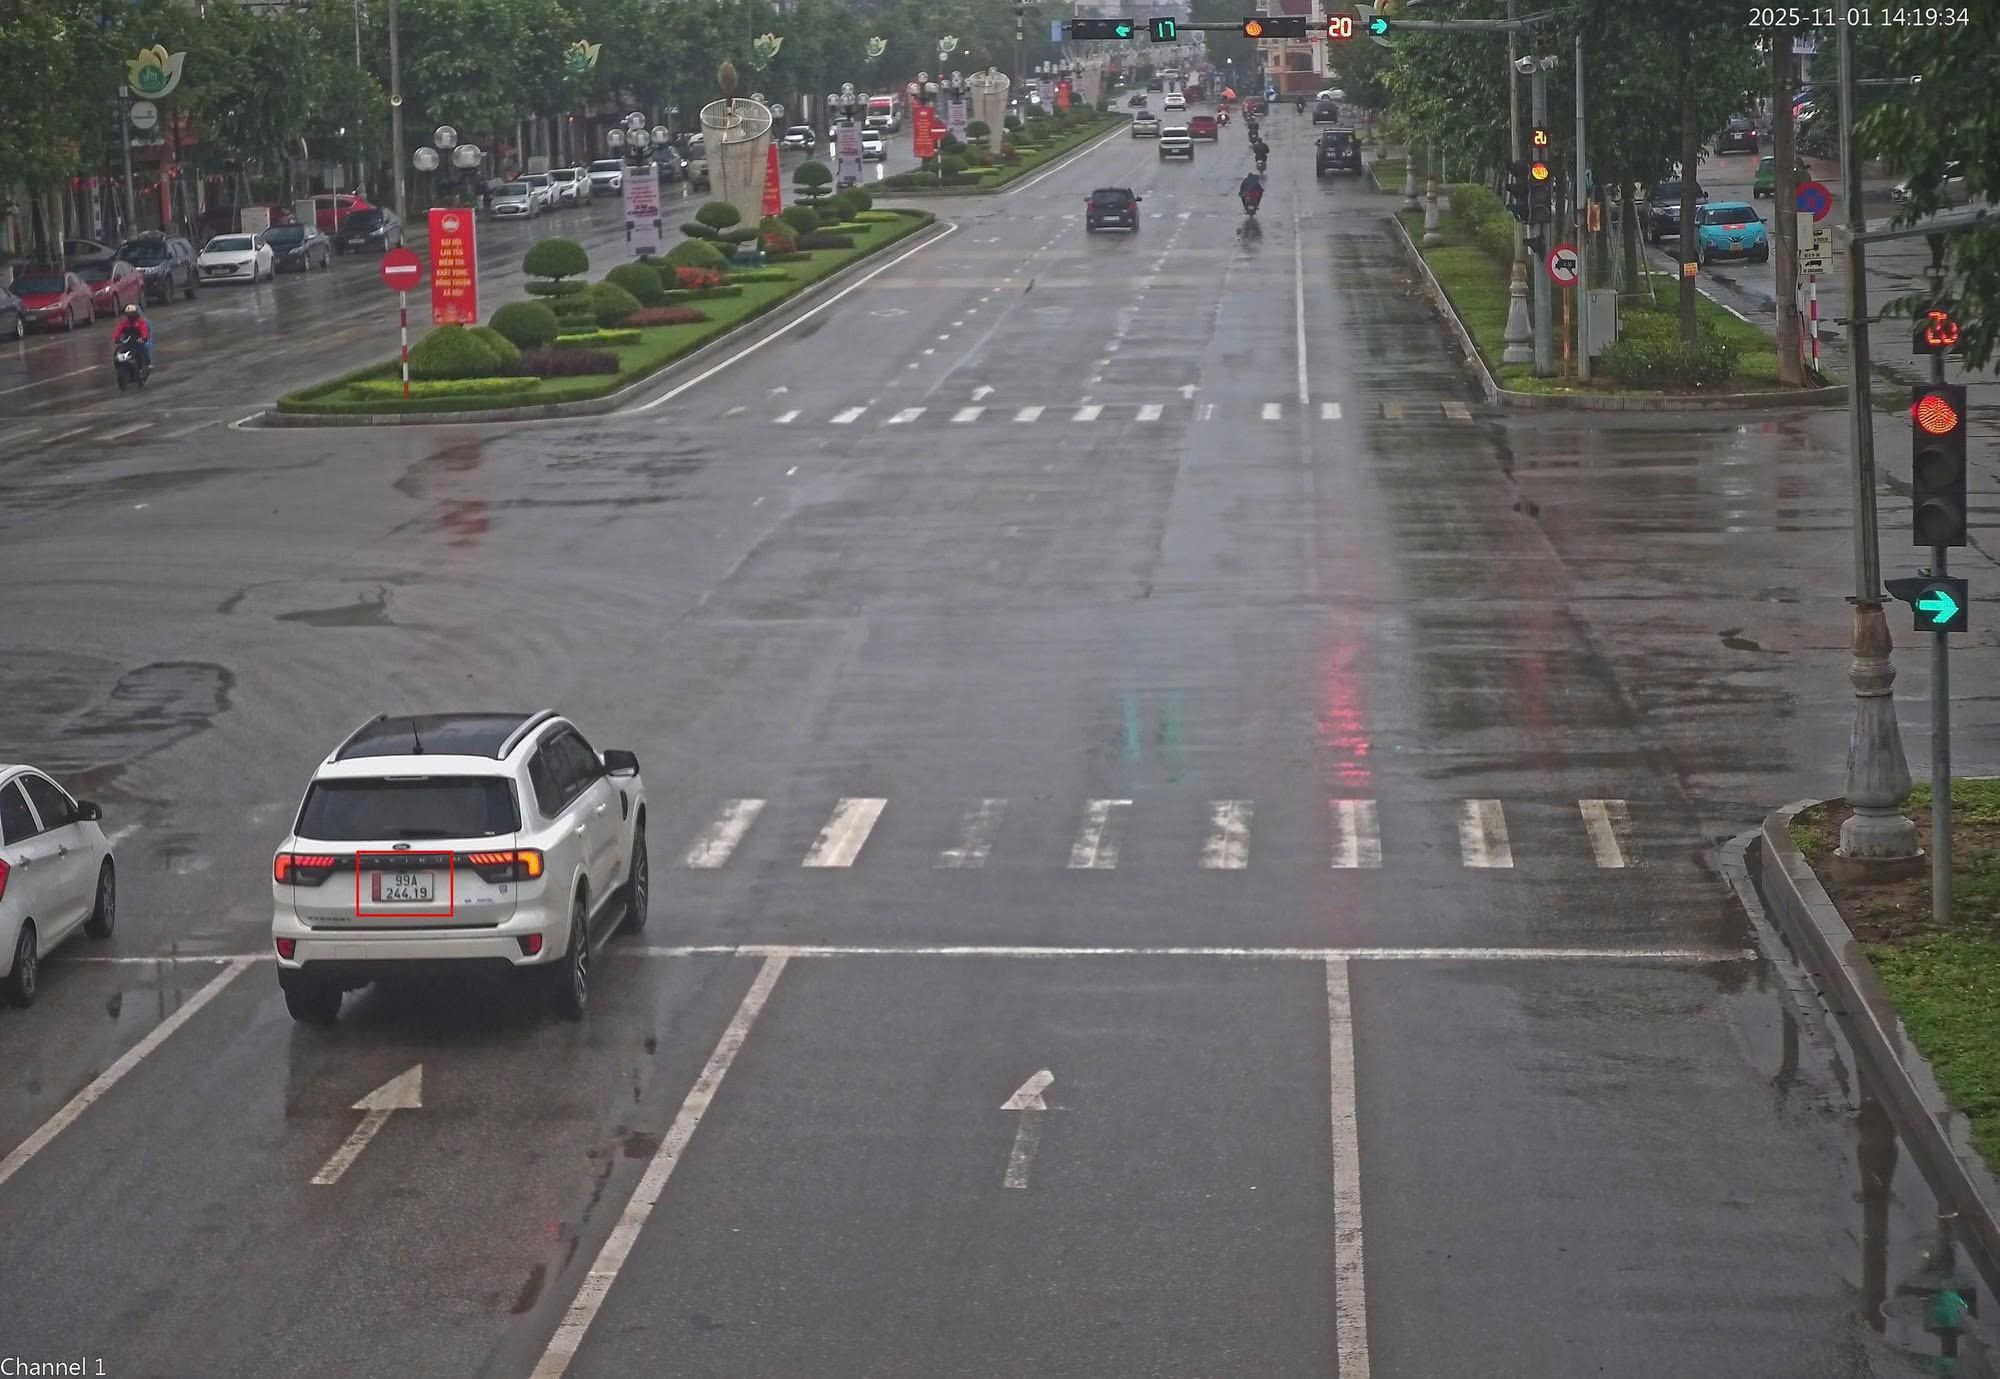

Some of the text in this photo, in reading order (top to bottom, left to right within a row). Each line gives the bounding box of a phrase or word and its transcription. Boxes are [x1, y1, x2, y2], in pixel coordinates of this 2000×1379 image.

[1157, 20, 1175, 38] 17
[1328, 17, 1352, 38] 20
[394, 874, 418, 887] 99A
[386, 887, 428, 900] 244.19
